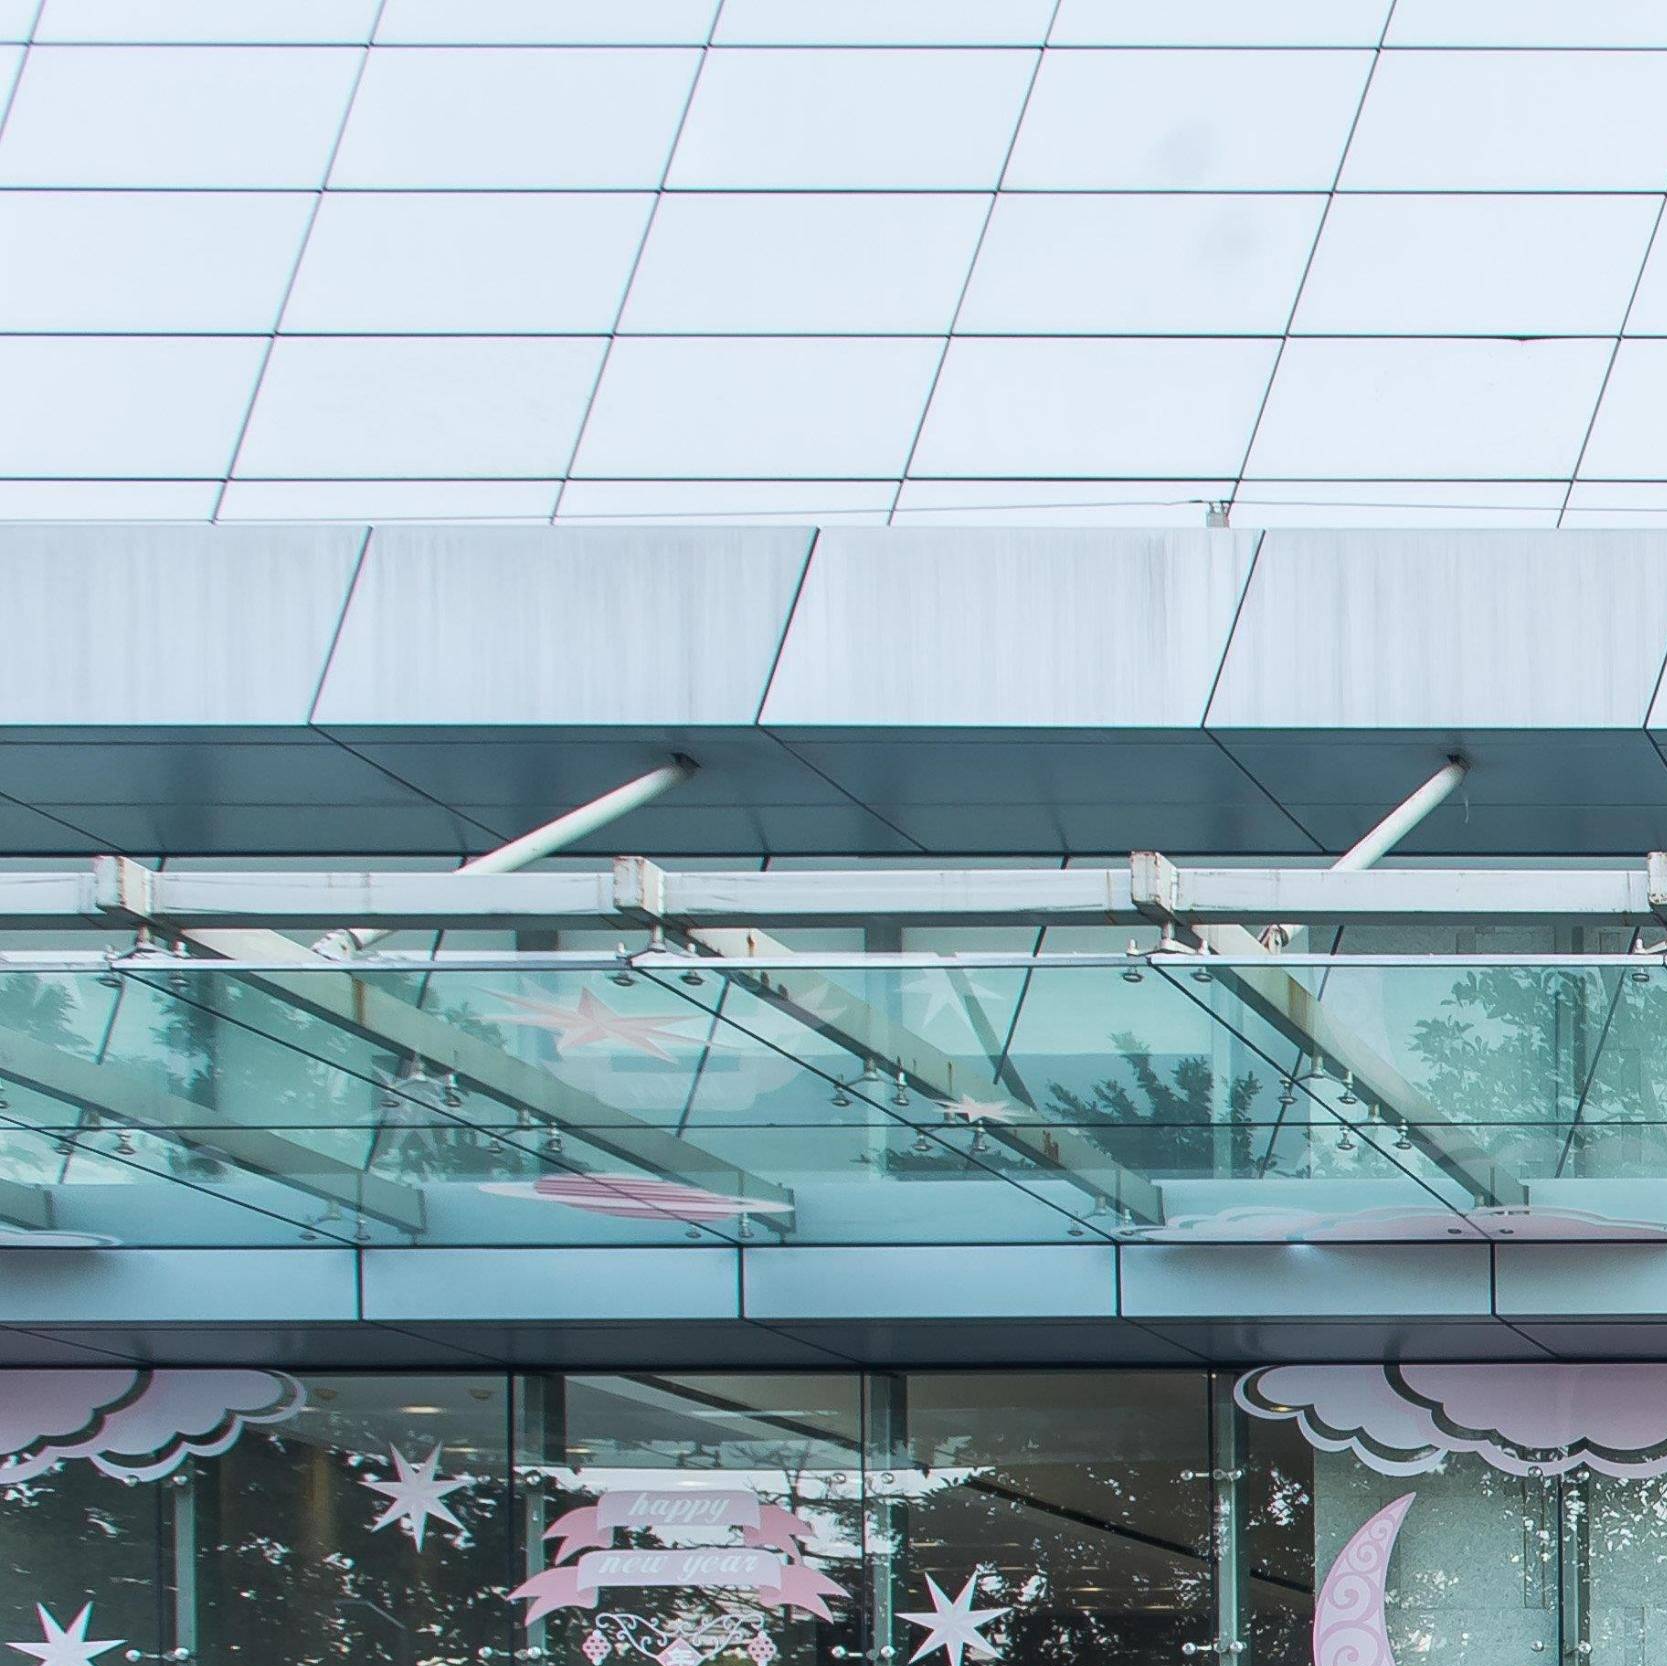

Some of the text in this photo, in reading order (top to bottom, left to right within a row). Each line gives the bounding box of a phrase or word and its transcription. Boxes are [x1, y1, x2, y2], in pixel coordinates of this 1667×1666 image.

[628, 1493, 731, 1524] happy
[599, 1553, 758, 1580] new year
